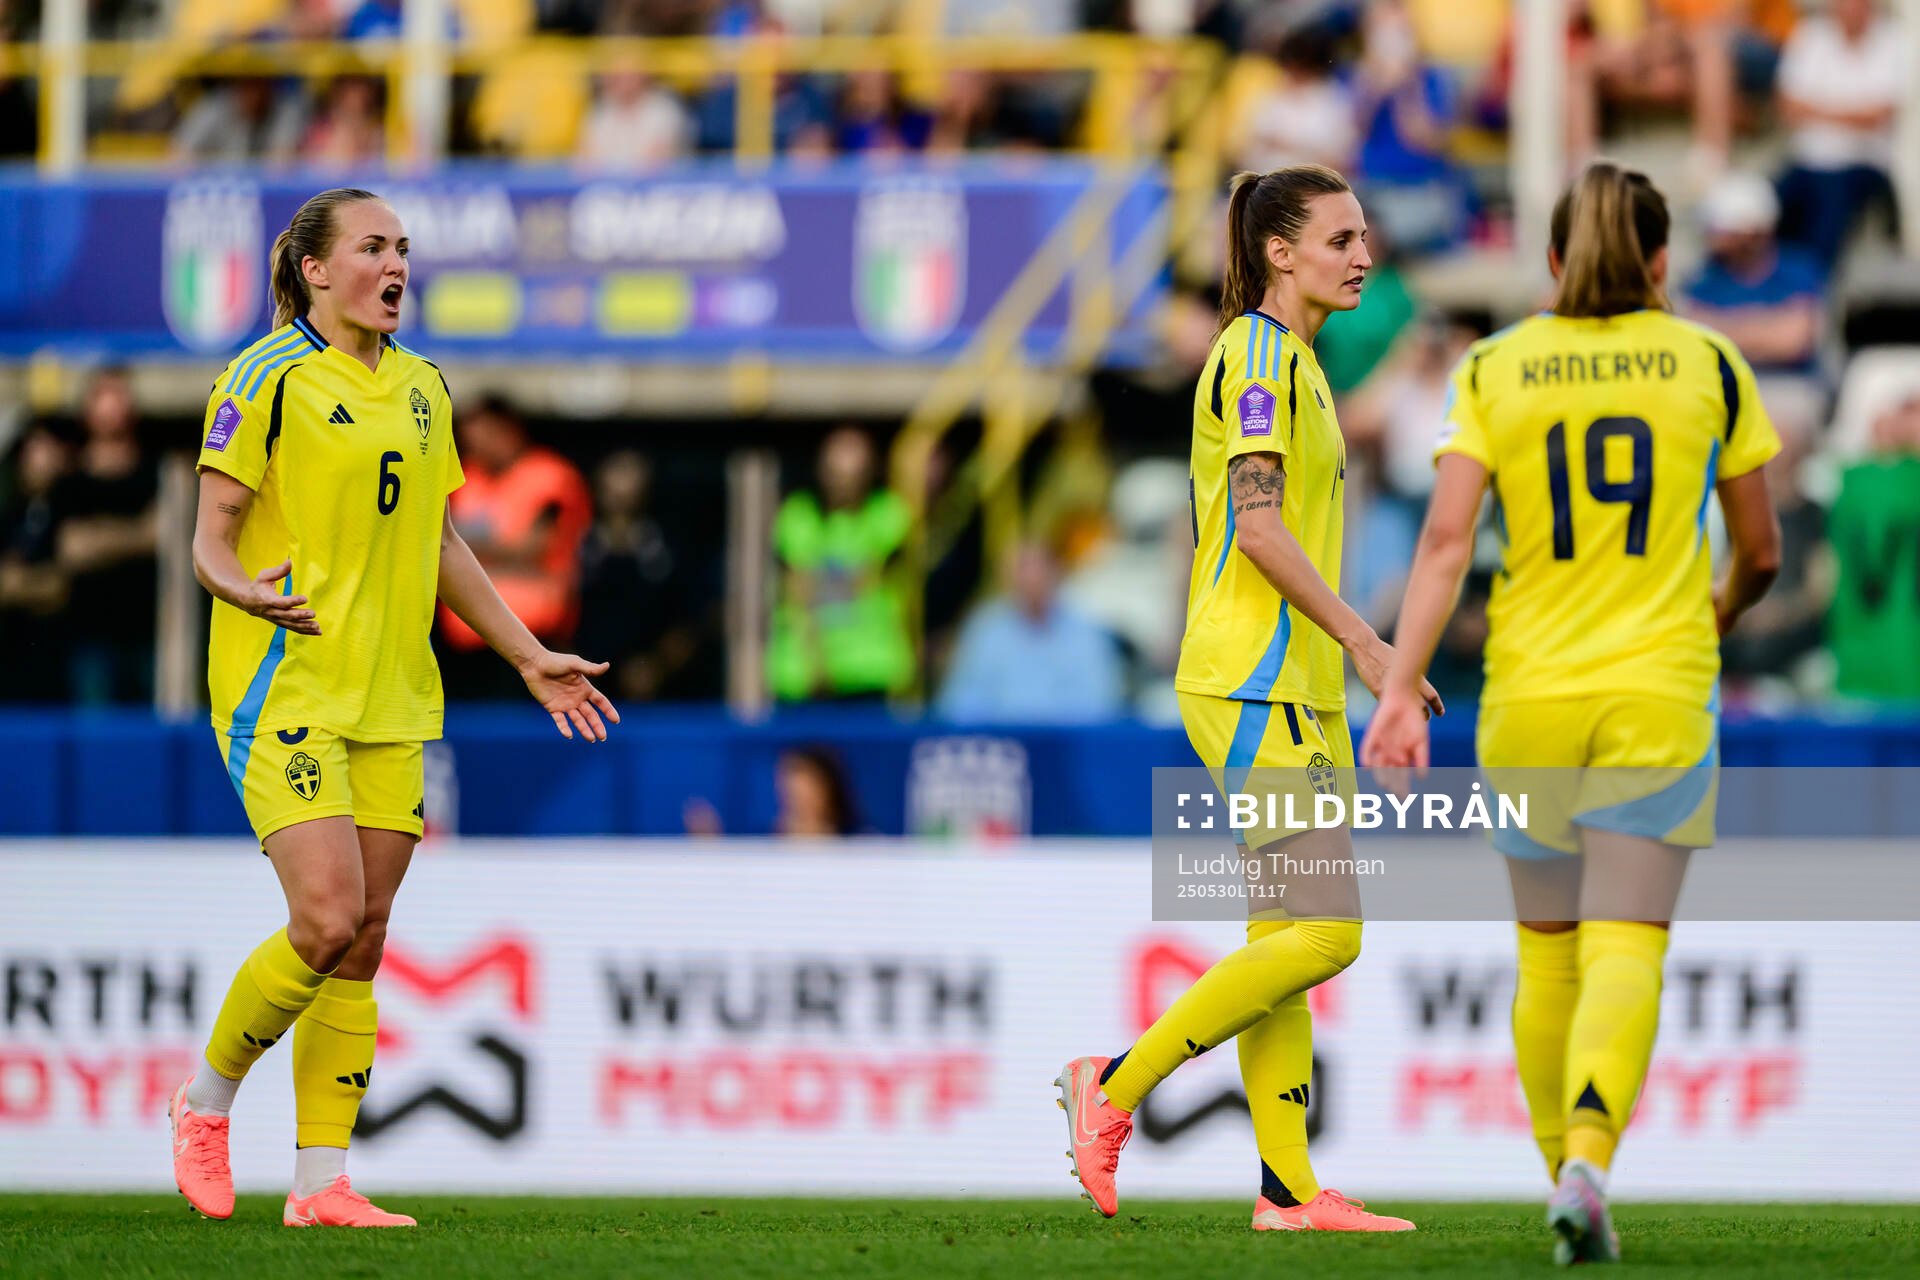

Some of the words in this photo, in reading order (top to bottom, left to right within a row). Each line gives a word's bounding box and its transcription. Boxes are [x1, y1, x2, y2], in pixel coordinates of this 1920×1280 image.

[1520, 351, 1678, 388] KANERYD
[378, 451, 404, 516] 6
[1545, 415, 1654, 561] 19
[600, 956, 992, 1033] WURTH
[1402, 958, 1802, 1034] WTH
[1398, 1052, 1803, 1134] MYF
